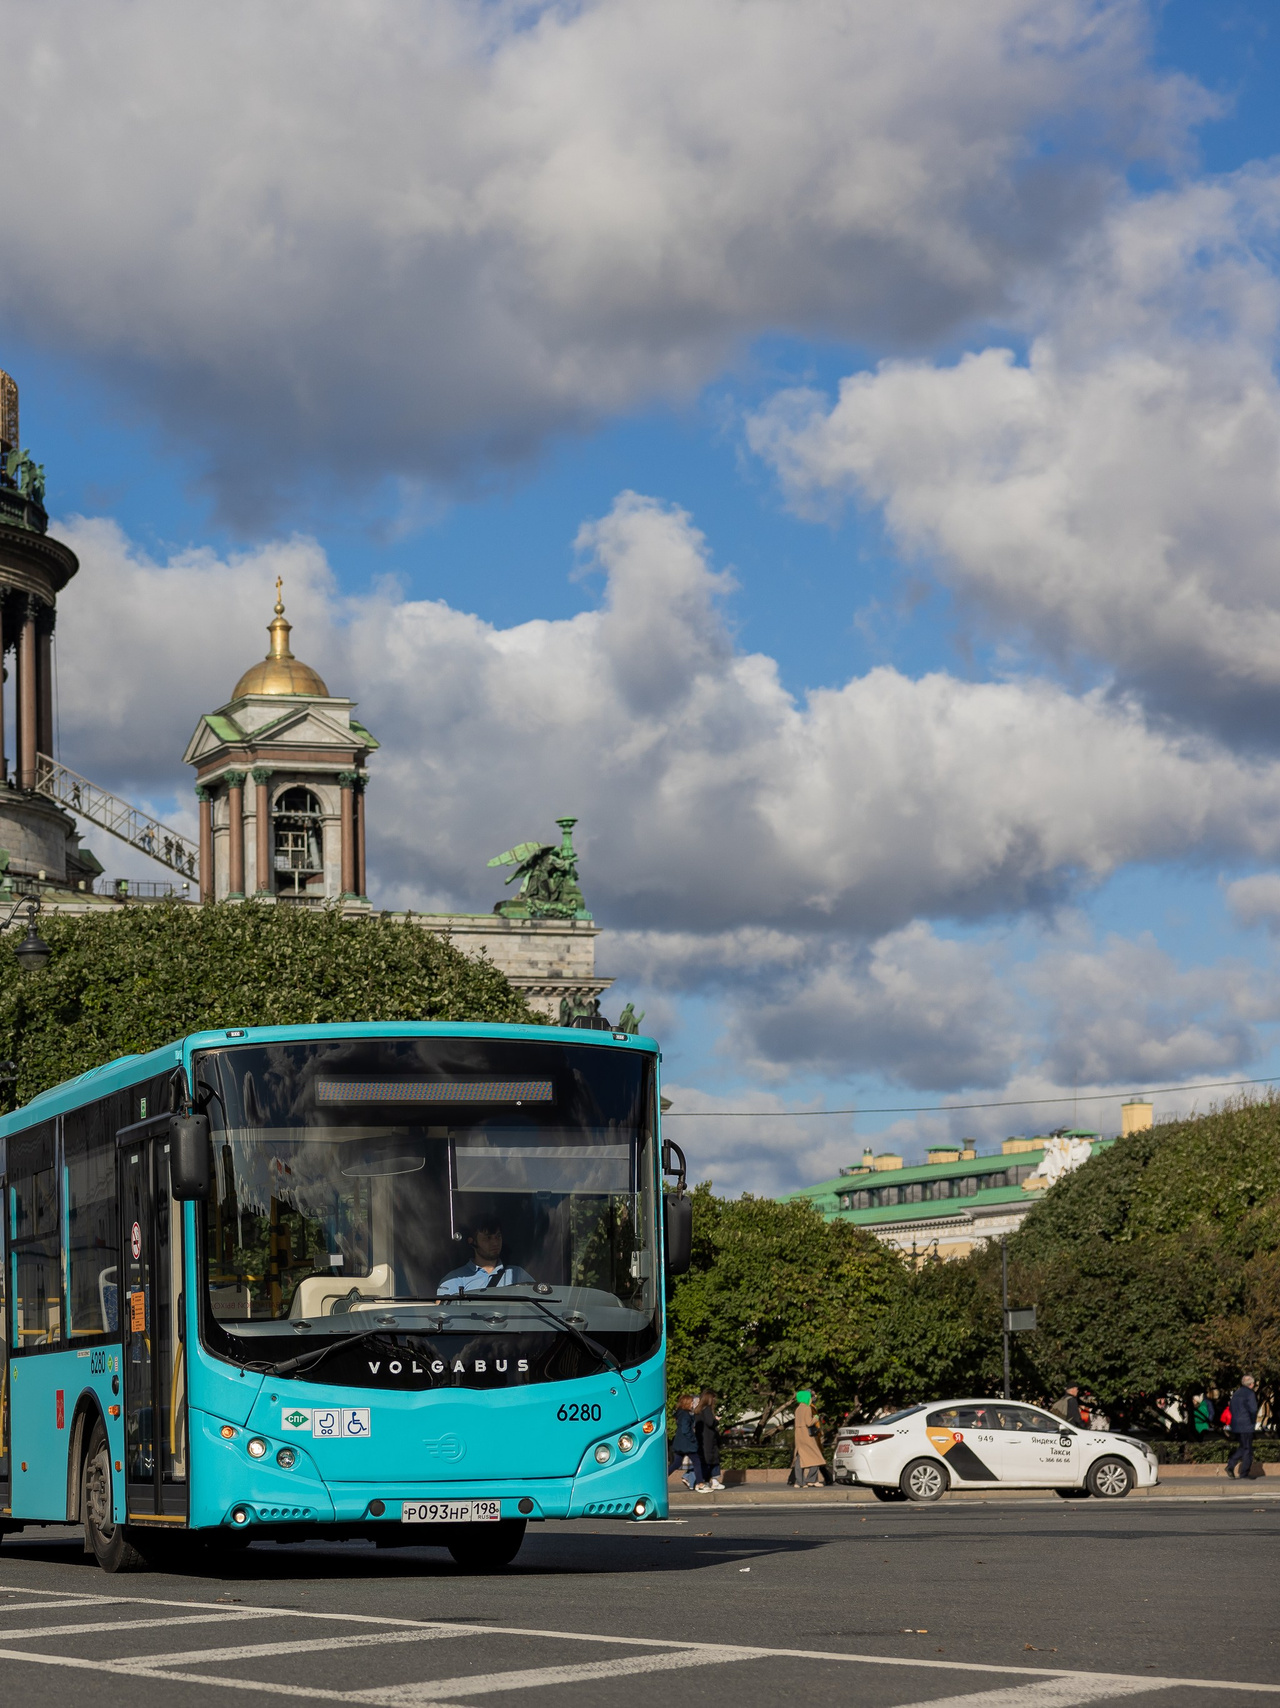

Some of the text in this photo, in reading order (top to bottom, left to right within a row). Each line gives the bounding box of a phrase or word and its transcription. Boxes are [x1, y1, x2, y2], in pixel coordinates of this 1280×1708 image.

[91, 1351, 106, 1374] 6280
[368, 1359, 529, 1375] VOLGABUS
[556, 1403, 602, 1422] 6280
[1031, 1437, 1058, 1445] Яндекс
[1060, 1438, 1072, 1447] Go
[1049, 1447, 1071, 1456] Такси
[408, 1502, 496, 1520] Р093НР 198
